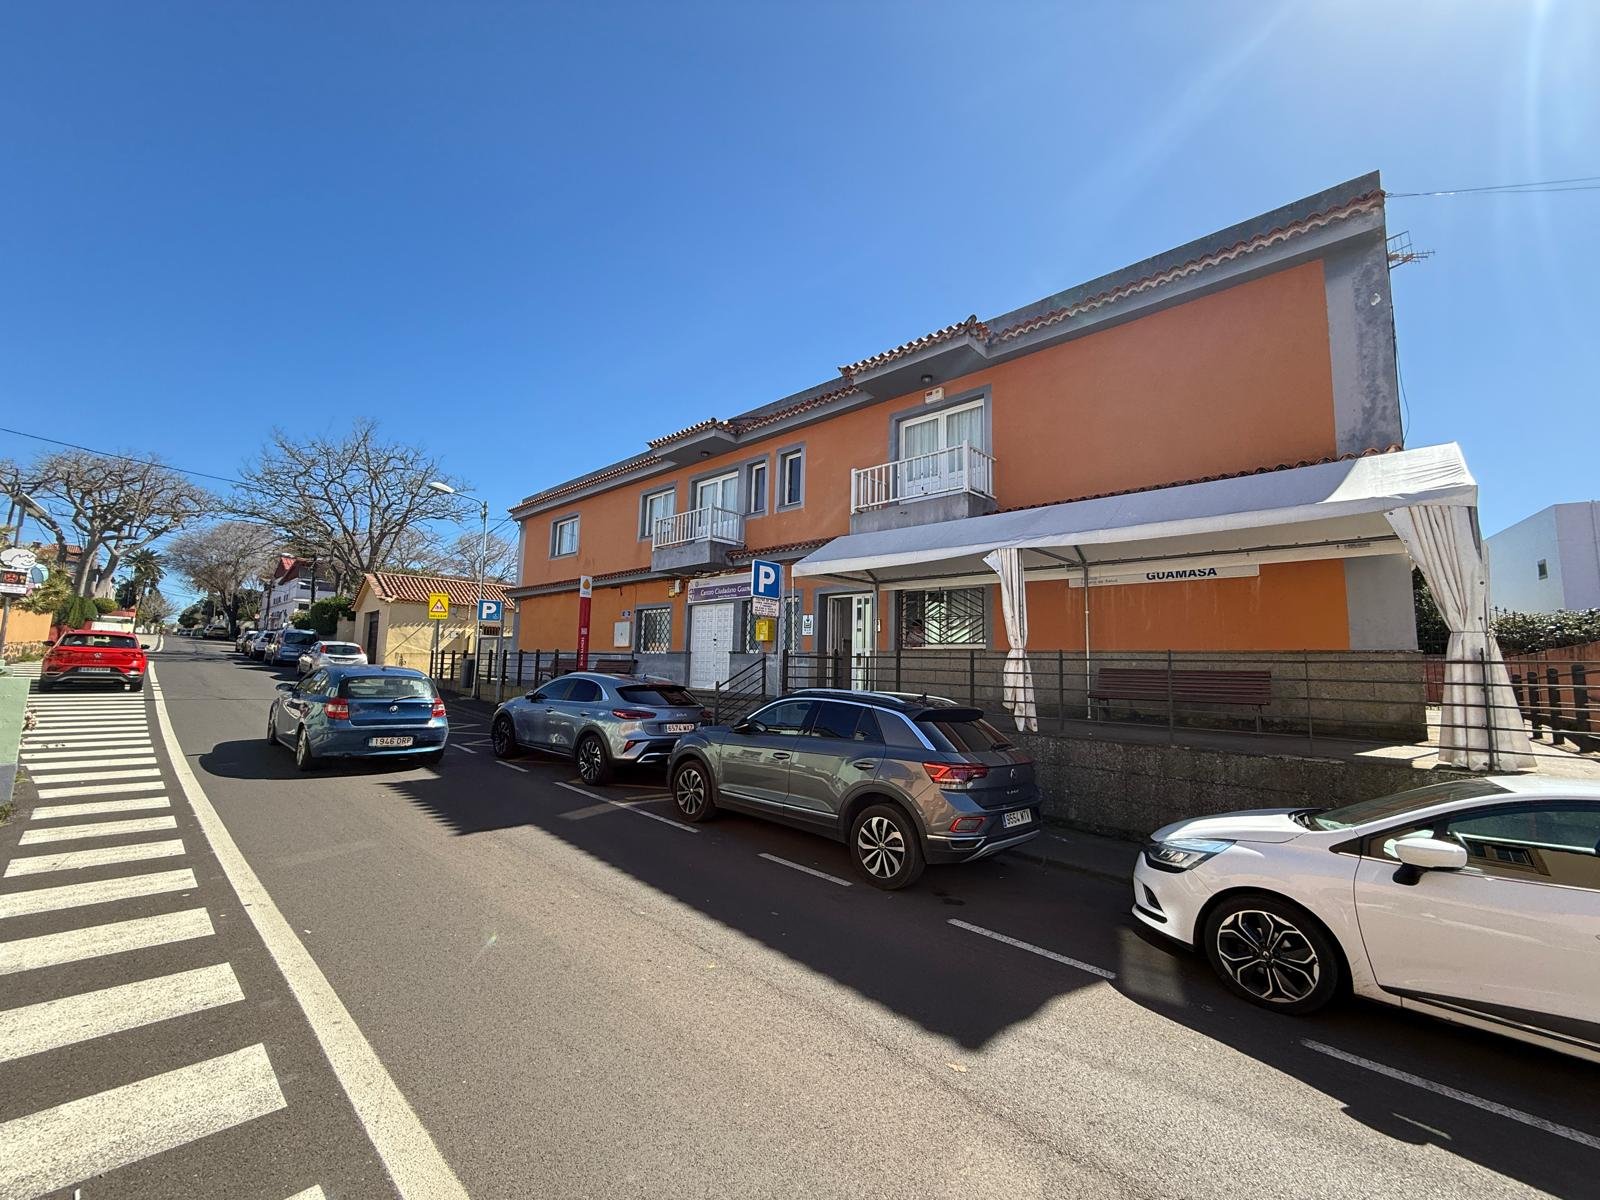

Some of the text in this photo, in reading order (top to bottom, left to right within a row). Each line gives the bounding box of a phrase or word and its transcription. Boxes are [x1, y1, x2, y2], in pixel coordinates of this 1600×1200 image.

[758, 565, 775, 593] P
[1146, 568, 1217, 580] GUAMASA
[714, 587, 737, 595] Ciudadano
[482, 602, 497, 619] P
[374, 737, 396, 746] 1946
